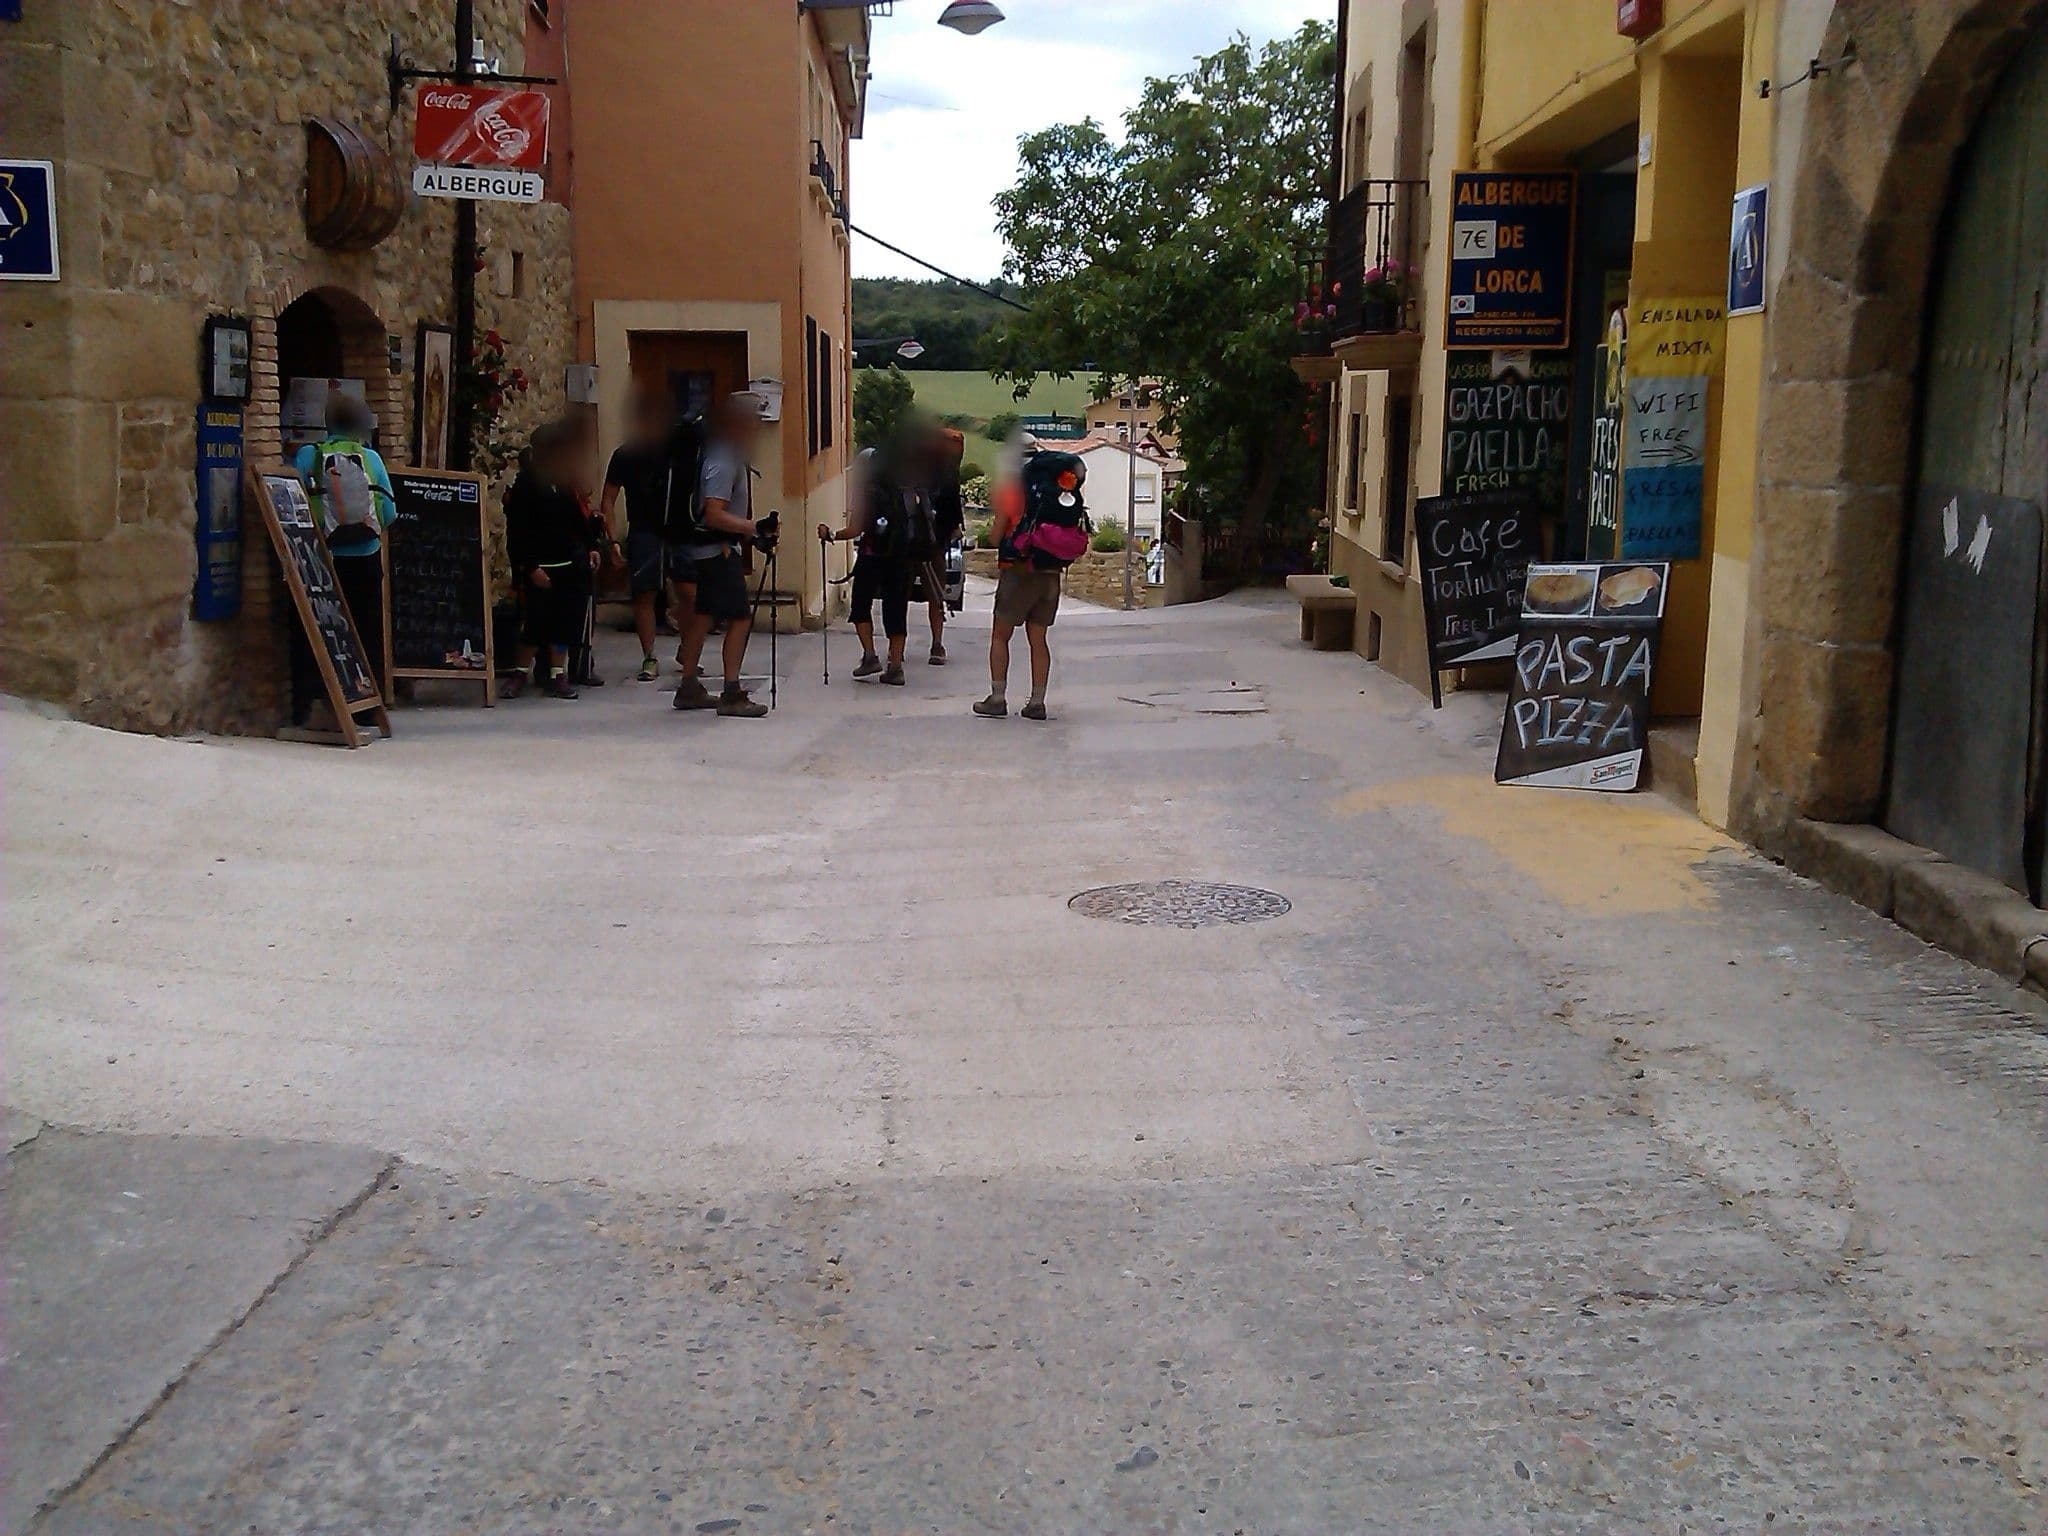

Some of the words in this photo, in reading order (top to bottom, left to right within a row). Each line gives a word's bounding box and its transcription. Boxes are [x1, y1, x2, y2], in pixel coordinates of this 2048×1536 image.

[423, 174, 534, 197] ALBERGUE
[1457, 178, 1570, 207] ALBERGUE
[1461, 230, 1488, 249] 7€
[1498, 223, 1526, 249] DE
[1474, 266, 1544, 294] LORCA
[1639, 308, 1724, 325] ENSALADA
[1655, 340, 1713, 358] MIXTA
[1450, 384, 1568, 422] GAZPACHO
[1639, 427, 1690, 444] FREE
[1446, 426, 1551, 477] PAELLA
[1455, 469, 1510, 494] FRESH
[1516, 633, 1651, 696] PASTA
[1514, 694, 1635, 750] PIZZA
